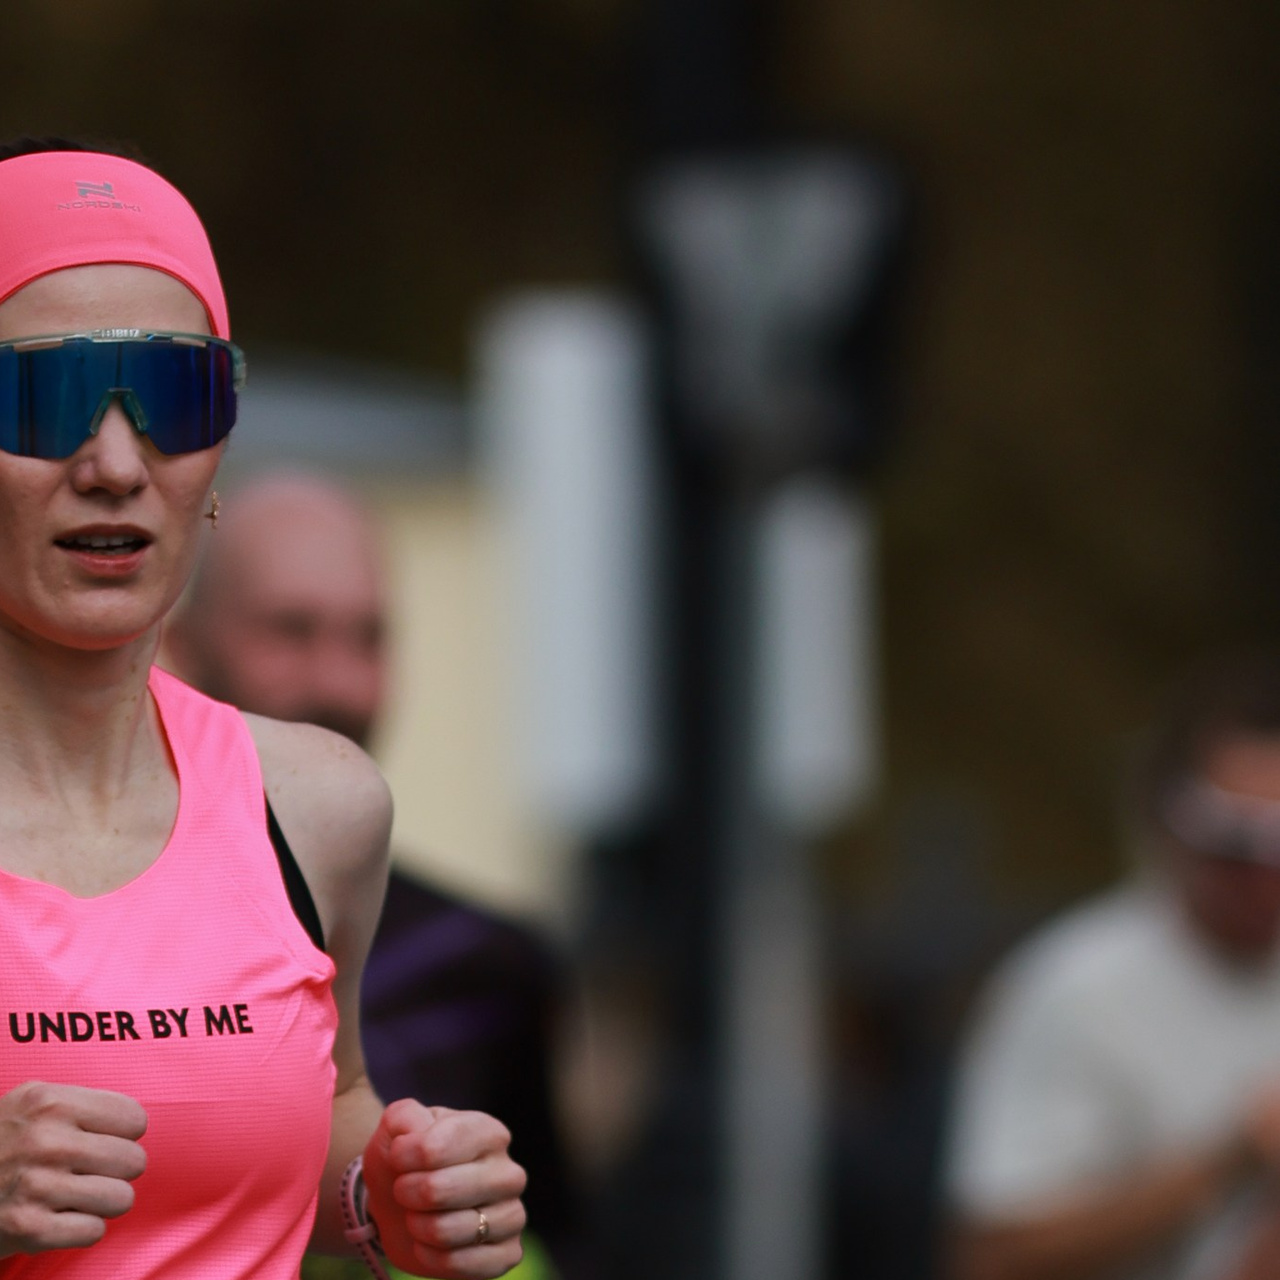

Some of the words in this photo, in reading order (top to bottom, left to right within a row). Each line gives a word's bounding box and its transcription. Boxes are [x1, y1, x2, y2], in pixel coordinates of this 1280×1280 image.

[9, 1010, 141, 1043] UNDER
[147, 1007, 189, 1039] BY
[203, 1003, 254, 1037] ME
